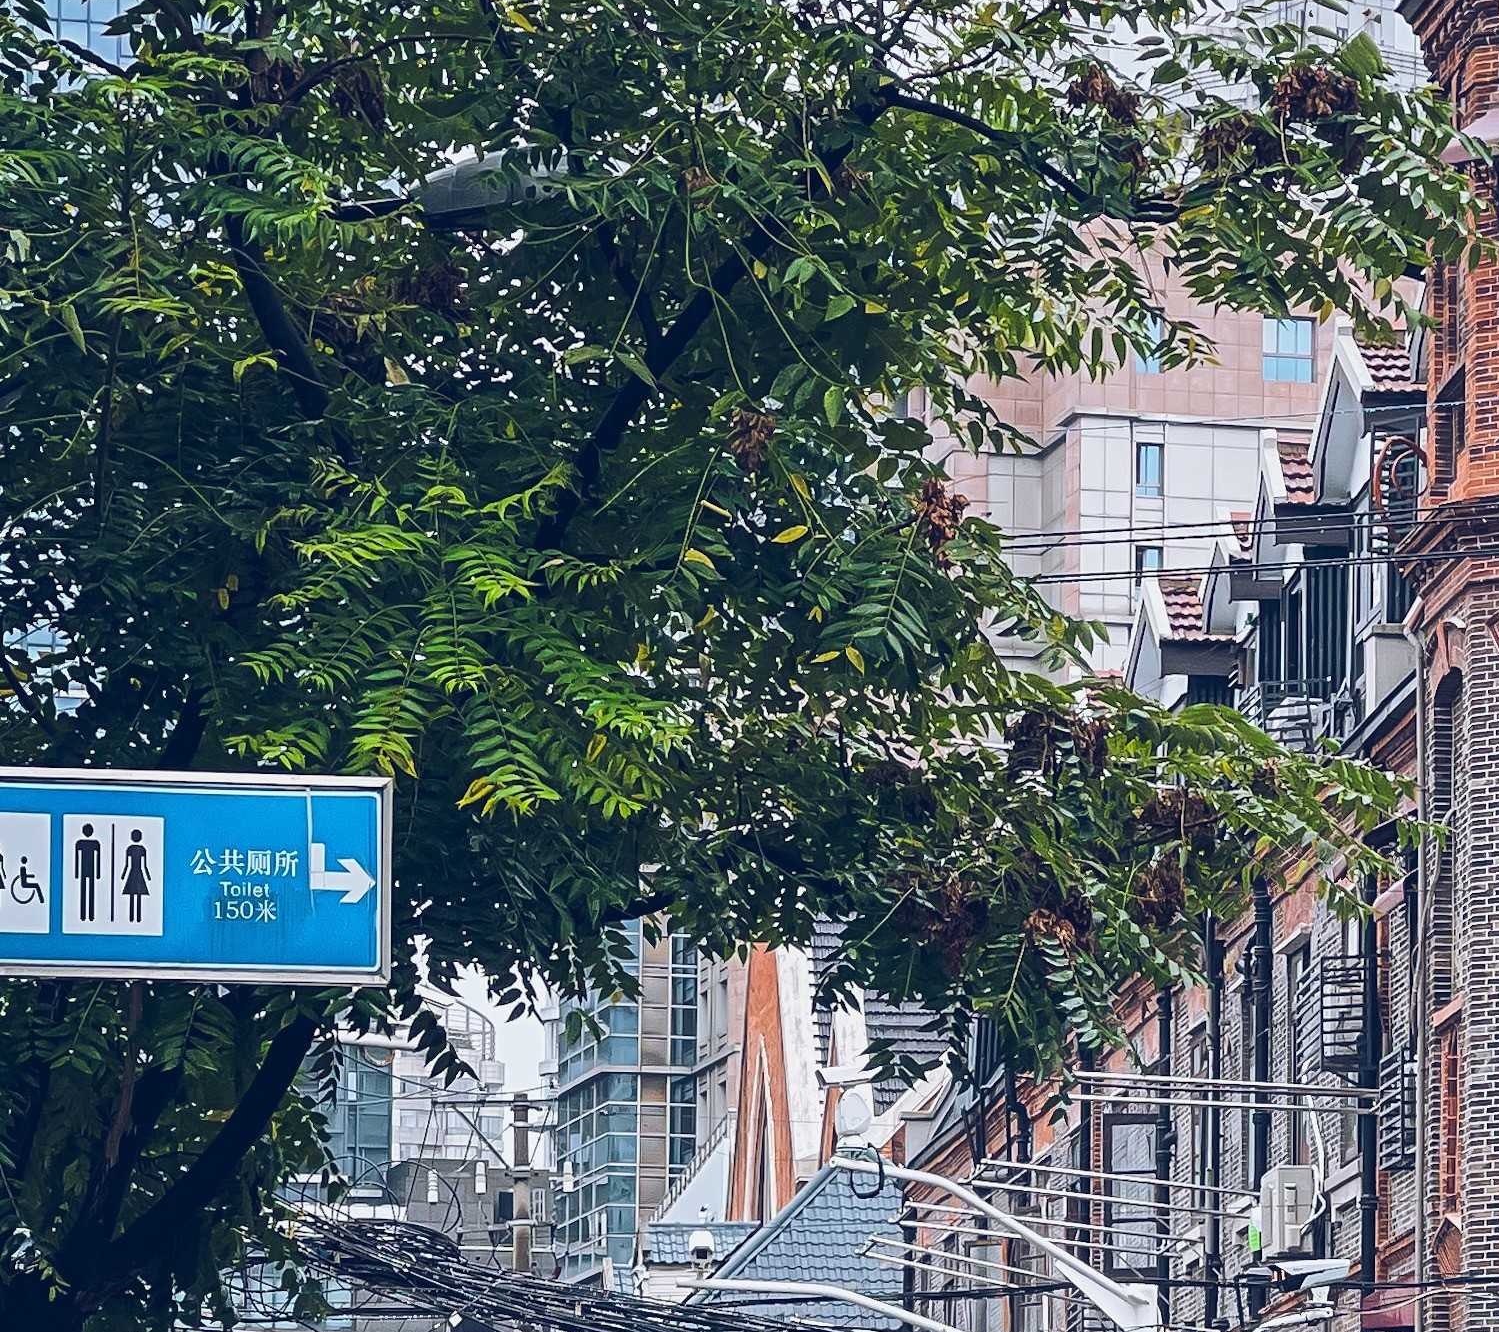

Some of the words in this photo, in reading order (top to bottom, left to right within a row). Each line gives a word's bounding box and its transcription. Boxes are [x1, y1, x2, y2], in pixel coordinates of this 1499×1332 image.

[190, 848, 299, 877] 公共厕所
[220, 881, 270, 897] Toilet
[214, 899, 277, 923] 150米
